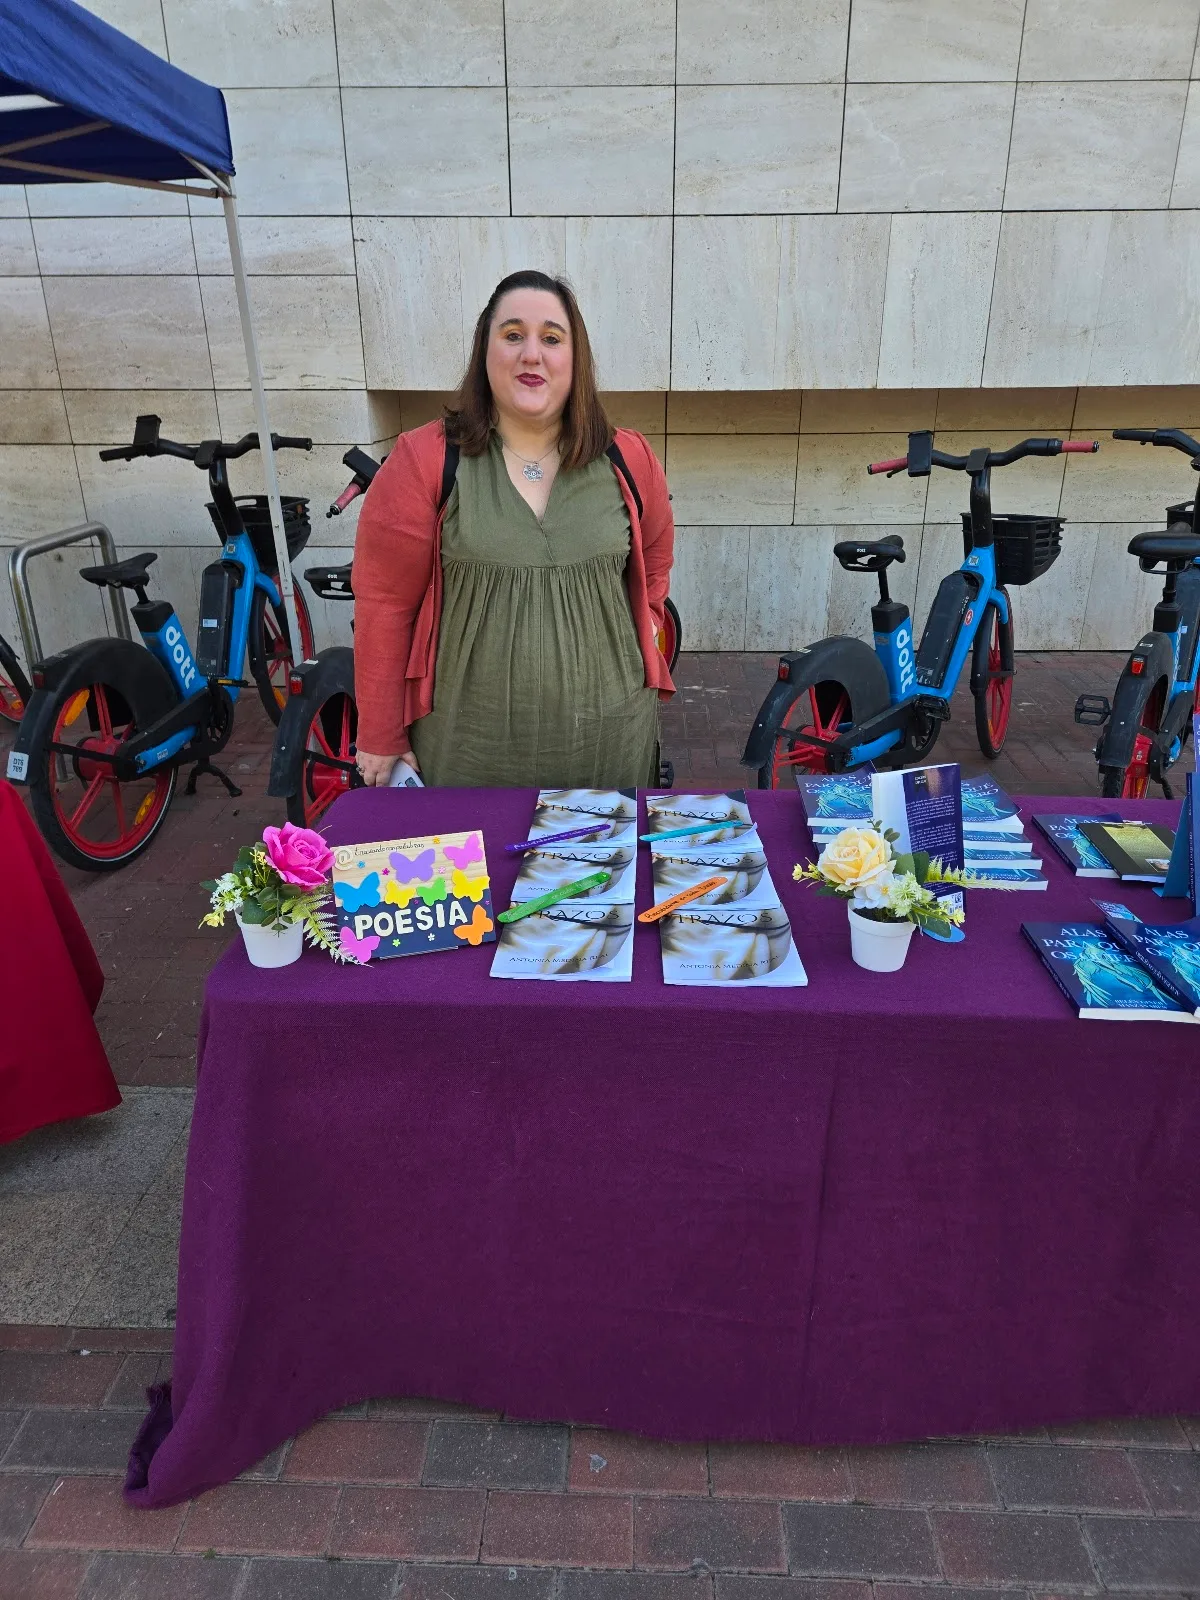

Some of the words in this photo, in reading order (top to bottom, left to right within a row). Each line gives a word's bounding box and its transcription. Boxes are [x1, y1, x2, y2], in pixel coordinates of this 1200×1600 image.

[165, 625, 196, 690] dott
[896, 629, 914, 694] dott
[550, 804, 625, 814] TRAZOS
[663, 811, 740, 819] TRAZOS
[540, 851, 624, 861] TRAZOS
[669, 857, 754, 866] TRAZOS
[354, 901, 468, 940] POESIA
[671, 912, 773, 925] TRAZOS
[1061, 928, 1108, 938] ALAS
[1145, 927, 1189, 939] ALAS
[1041, 939, 1092, 949] PARA
